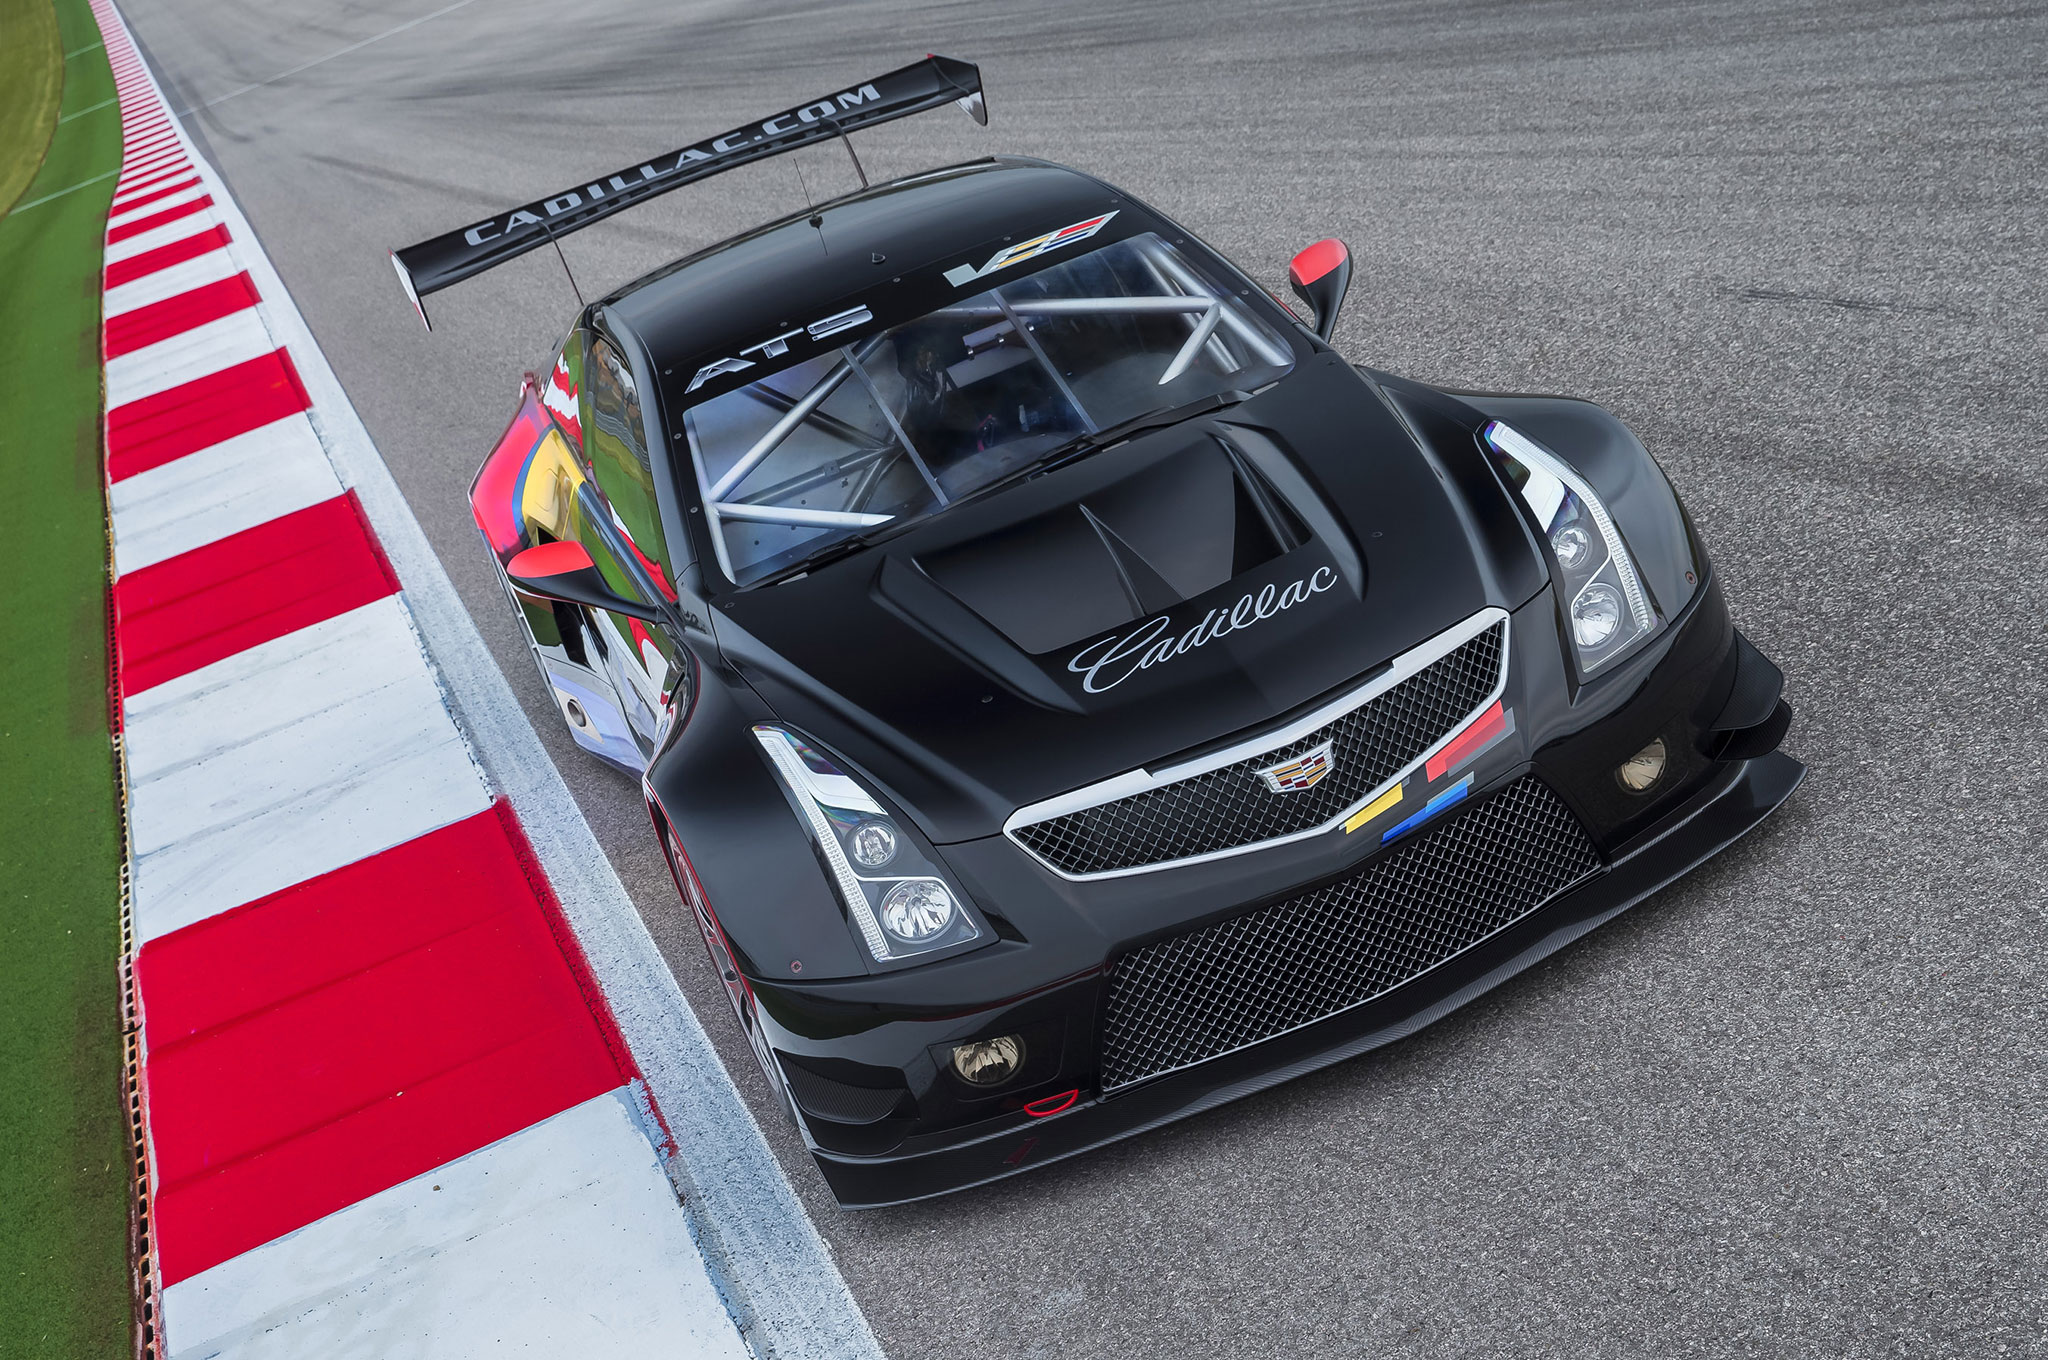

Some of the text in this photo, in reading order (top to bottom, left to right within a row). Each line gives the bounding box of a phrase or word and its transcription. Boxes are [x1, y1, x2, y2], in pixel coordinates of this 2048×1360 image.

[464, 83, 882, 247] CADILLAC.COM
[684, 304, 874, 394] ATS
[1067, 566, 1338, 694] Cadillac
